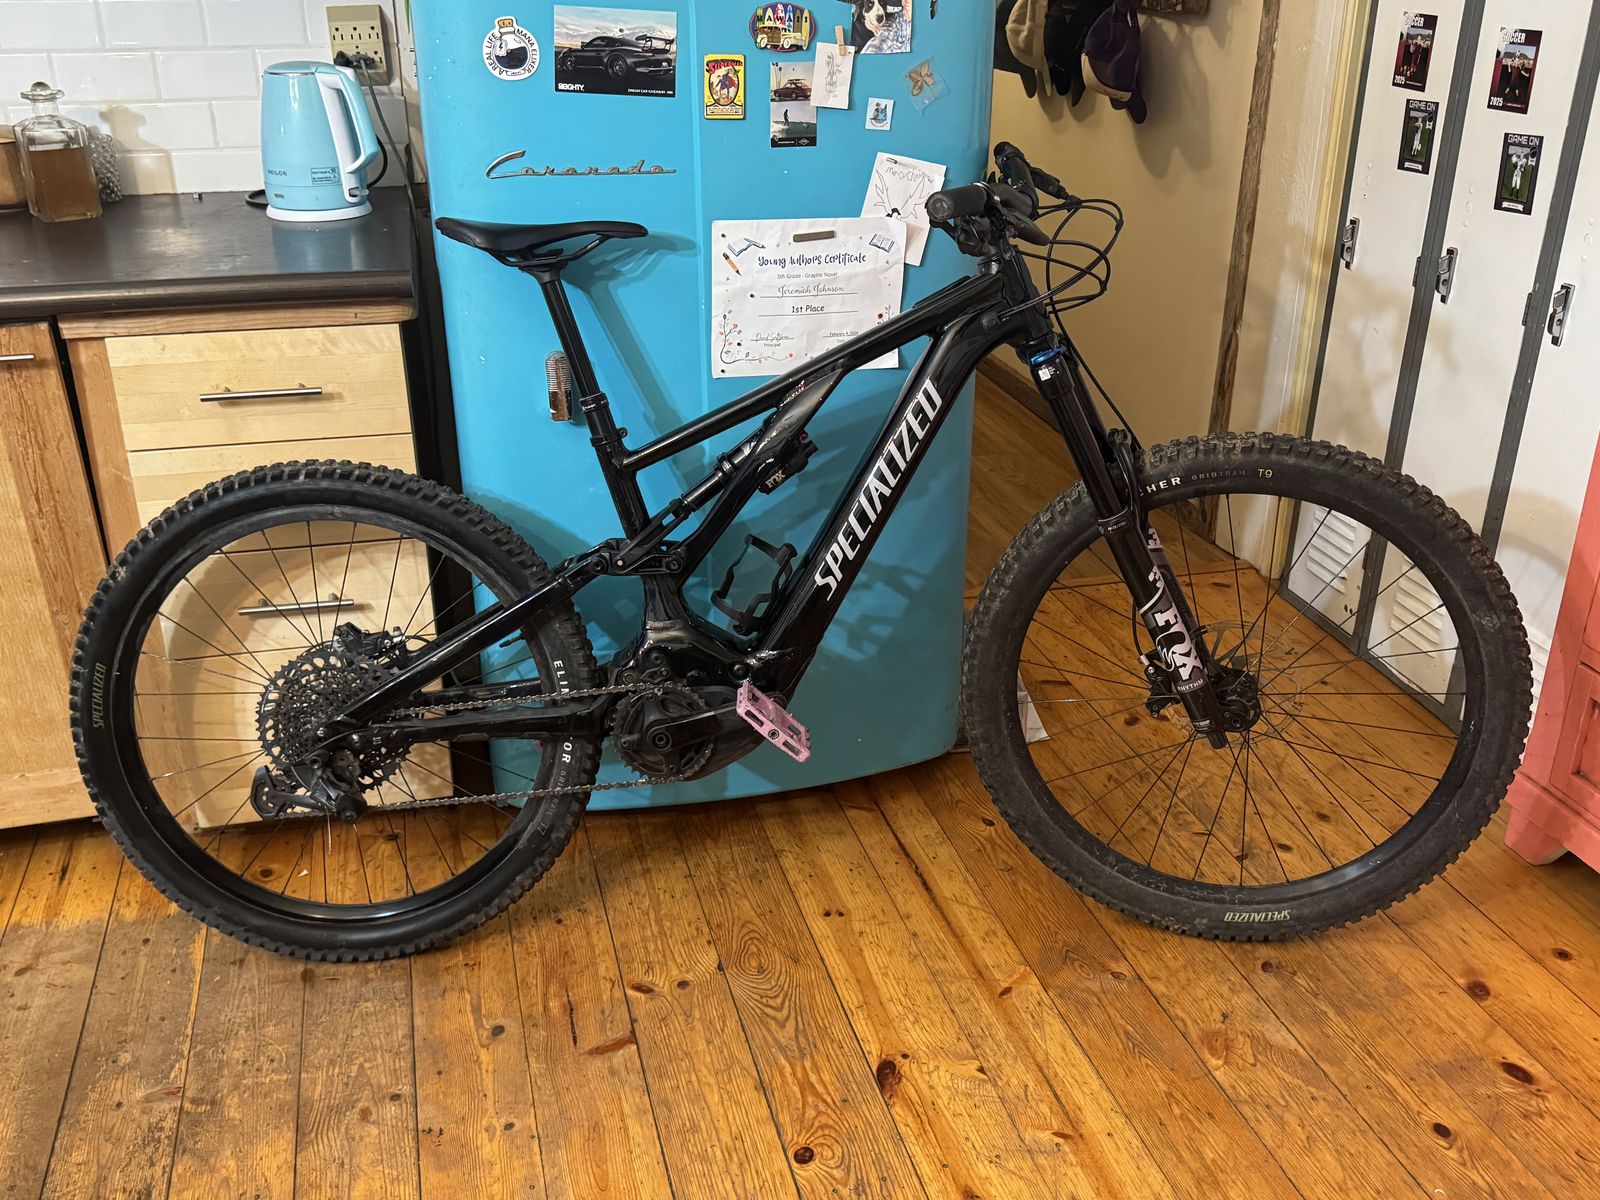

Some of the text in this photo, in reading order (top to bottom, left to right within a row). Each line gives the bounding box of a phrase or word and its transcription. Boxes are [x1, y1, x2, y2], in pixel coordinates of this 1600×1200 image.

[756, 15, 808, 23] HAWAII
[1404, 15, 1425, 27] SOCCER
[485, 32, 499, 49] LIFE
[516, 28, 535, 48] MANA
[1502, 32, 1526, 44] SOCCER
[485, 51, 499, 71] REAL
[1394, 75, 1406, 85] 2025
[1409, 100, 1436, 111] GAME ON
[1489, 96, 1504, 107] 2025
[1507, 134, 1540, 146] GAME ON
[486, 150, 676, 179] Coronado
[758, 256, 786, 269] Young
[824, 252, 867, 266] Certificate
[805, 272, 823, 280] Graphic
[777, 282, 844, 299] Jeremiah Johnson
[791, 304, 825, 313] 1st Place
[765, 470, 786, 489] FOX
[1257, 468, 1273, 479] T9
[815, 377, 942, 601] SPECIALIZED
[1154, 602, 1203, 681] FOX
[1177, 679, 1204, 691] RHYTHM
[92, 662, 106, 729] SPECIALIZED
[1224, 909, 1292, 923] SPECIALIZED
